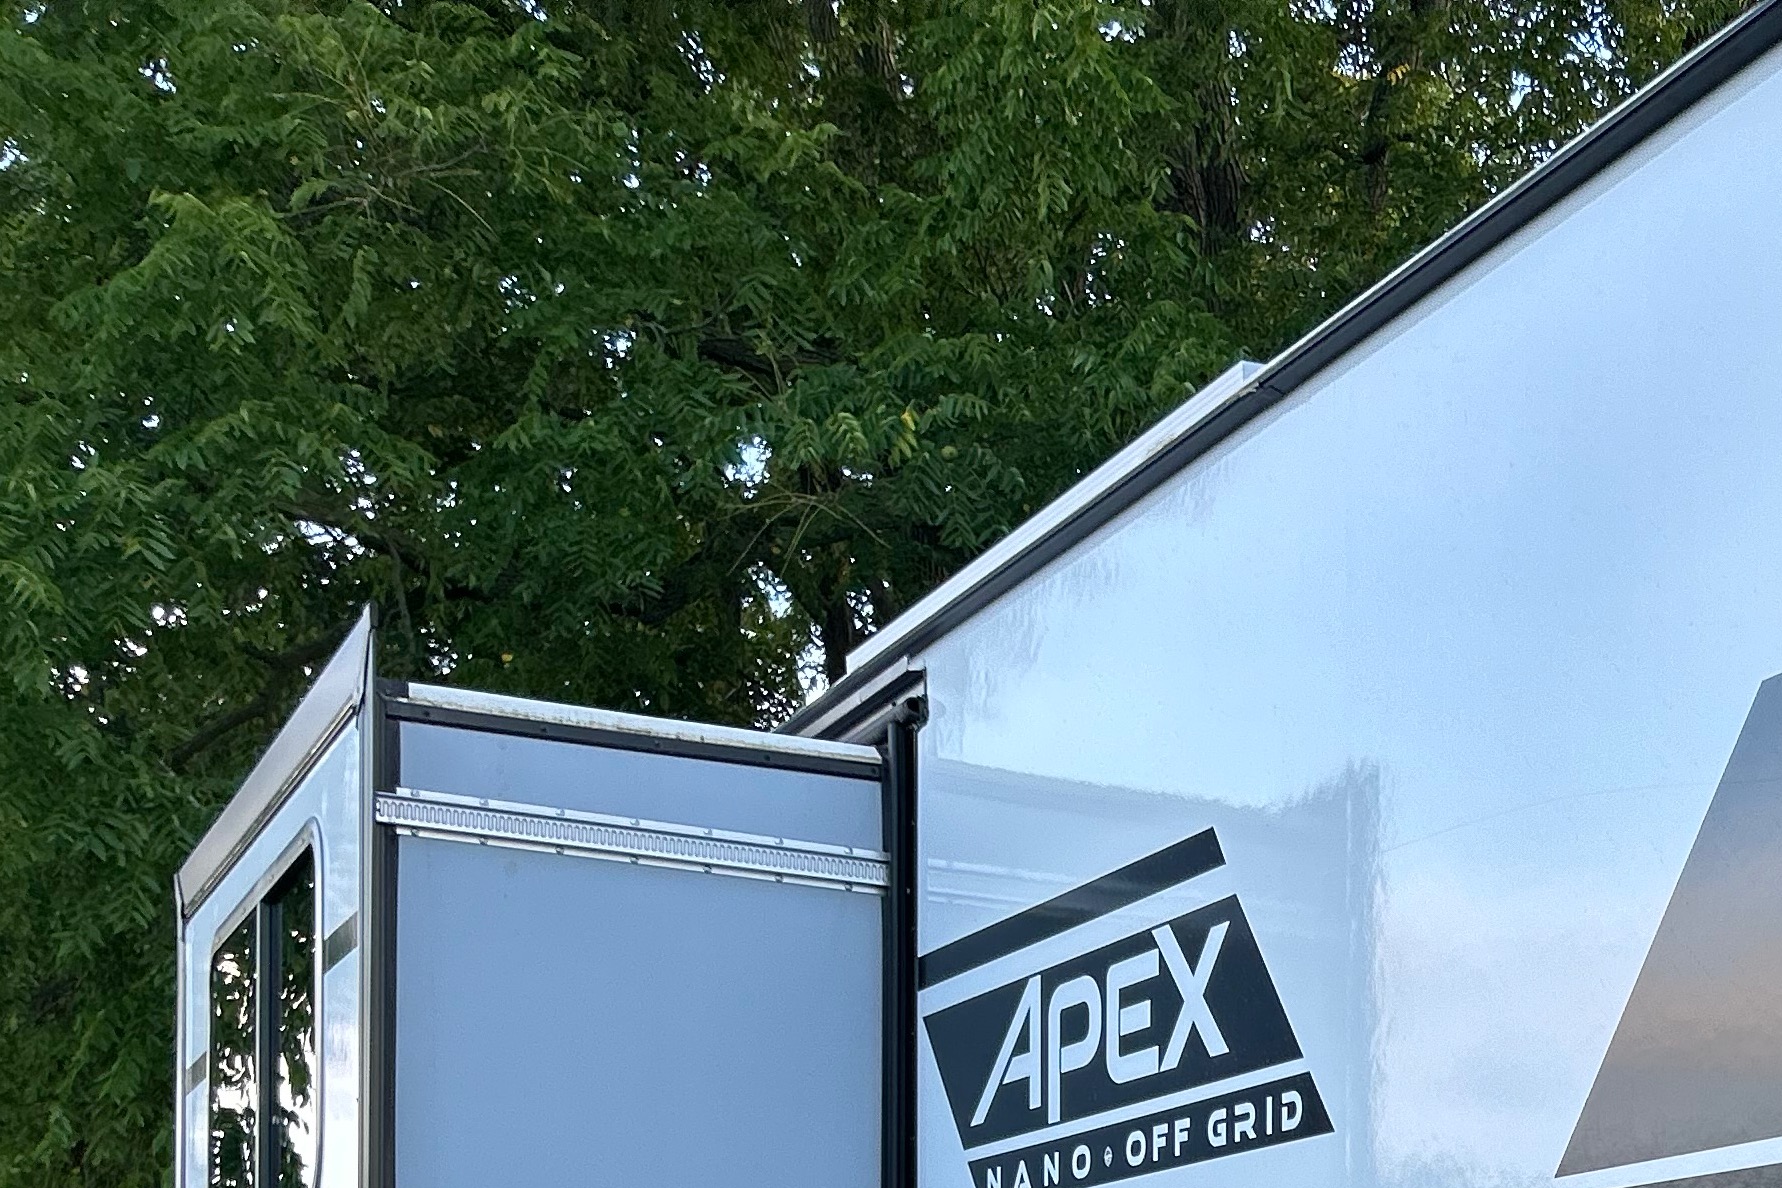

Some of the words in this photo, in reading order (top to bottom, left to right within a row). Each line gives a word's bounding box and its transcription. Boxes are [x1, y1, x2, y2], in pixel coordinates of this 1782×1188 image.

[970, 920, 1230, 1128] APEX
[1126, 1117, 1191, 1167] OFF
[1207, 1090, 1303, 1148] GRID
